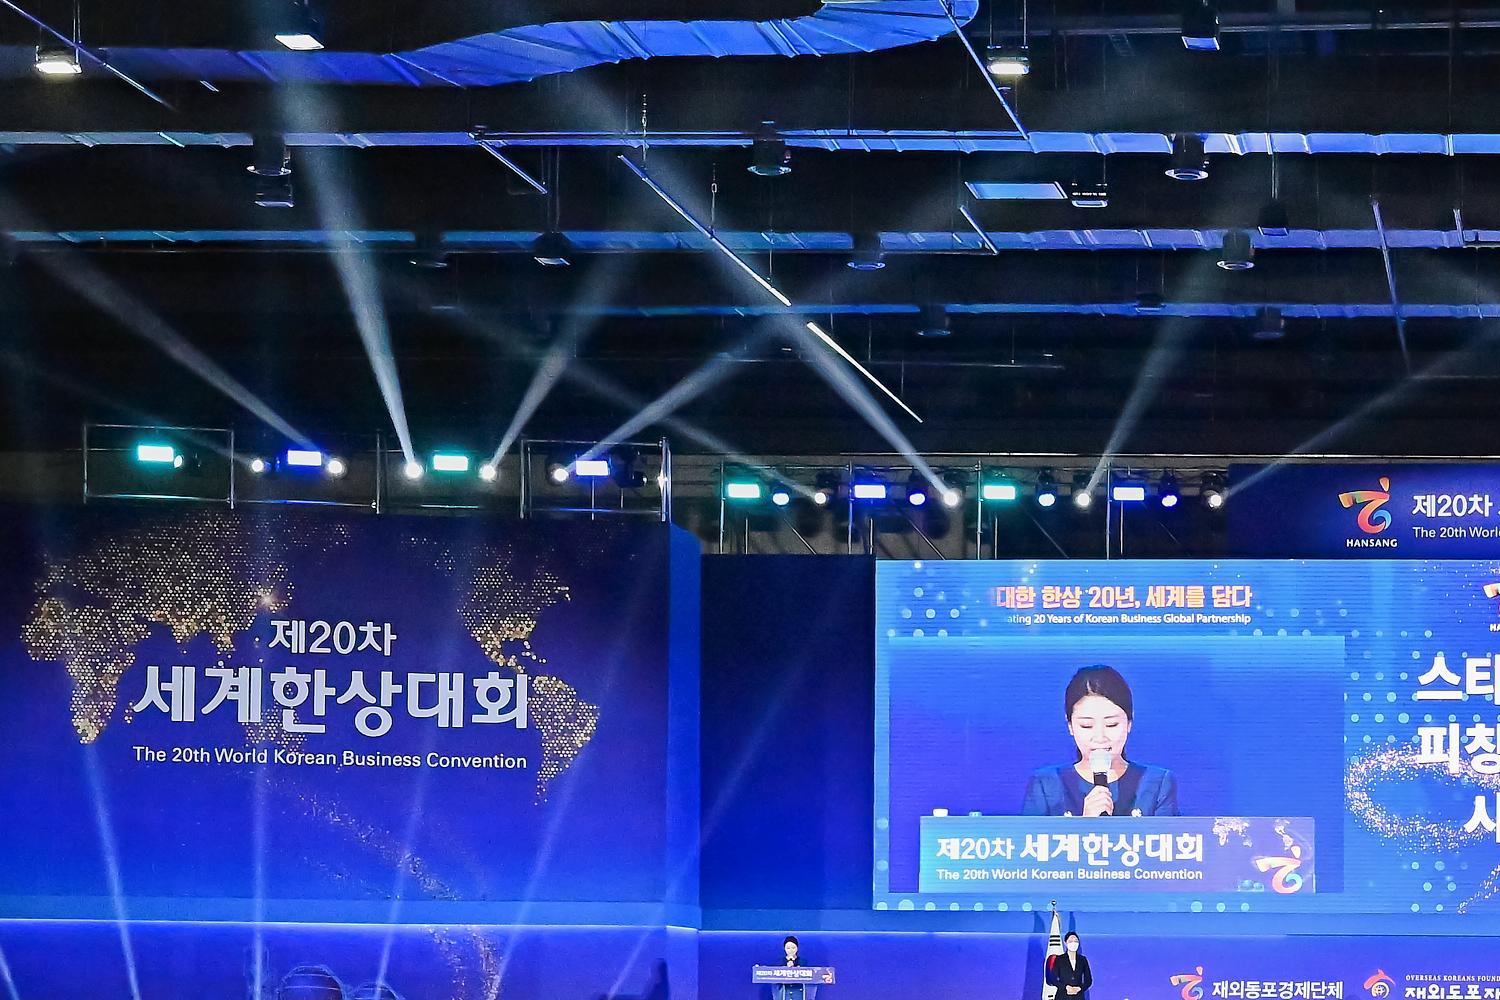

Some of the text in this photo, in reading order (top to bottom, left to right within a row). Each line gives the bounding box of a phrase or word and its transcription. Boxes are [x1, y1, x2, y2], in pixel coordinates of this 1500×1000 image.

[1412, 494, 1493, 518] 제20차
[1412, 526, 1436, 538] The
[1439, 526, 1467, 538] 20th
[1346, 539, 1398, 548] HANSANG
[992, 586, 1036, 609] 대한
[1041, 586, 1083, 609] 한상
[1145, 585, 1205, 608] 세계를
[1212, 585, 1253, 608] 담다
[1034, 614, 1046, 624] 20
[1047, 614, 1072, 624] Years
[1073, 614, 1085, 624] of
[1085, 614, 1119, 624] Korean
[1121, 614, 1162, 624] Business
[1163, 614, 1194, 624] Global
[1196, 614, 1251, 625] Partnership
[268, 620, 397, 656] 제20차
[133, 665, 528, 737] 세계한상대회
[133, 746, 527, 768] The 20th World Korean Business Convention
[936, 833, 1203, 867] 제20차 세계한상대회
[936, 869, 1203, 880] The 20th World Korean Business Convention
[1405, 974, 1442, 982] OVERSEAS
[1212, 981, 1343, 999] 재외동포경제단체
